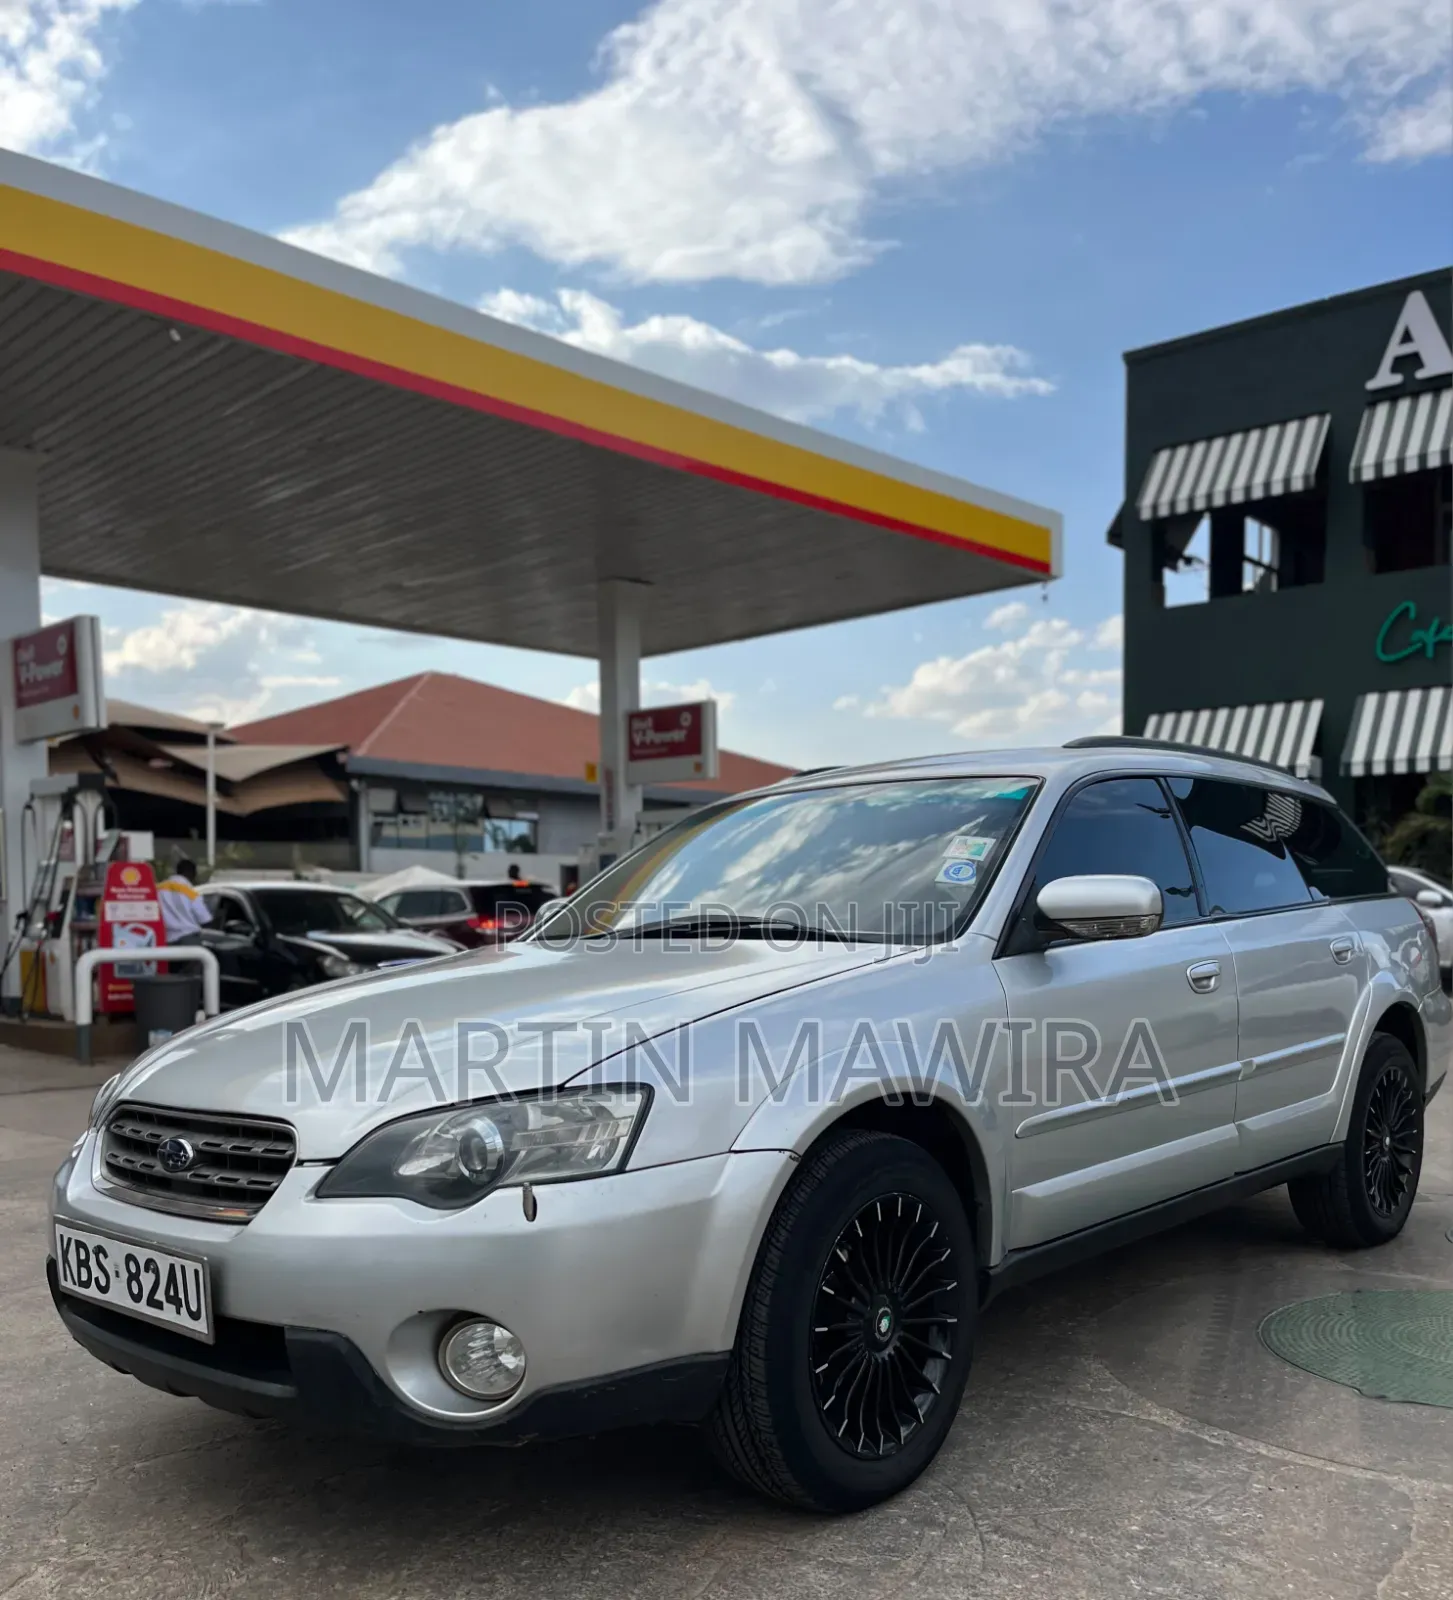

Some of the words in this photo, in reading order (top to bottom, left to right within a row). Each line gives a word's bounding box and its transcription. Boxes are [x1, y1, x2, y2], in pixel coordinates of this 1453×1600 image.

[1364, 289, 1453, 391] A
[59, 1233, 111, 1295] KBS
[124, 1253, 202, 1321] 824U
